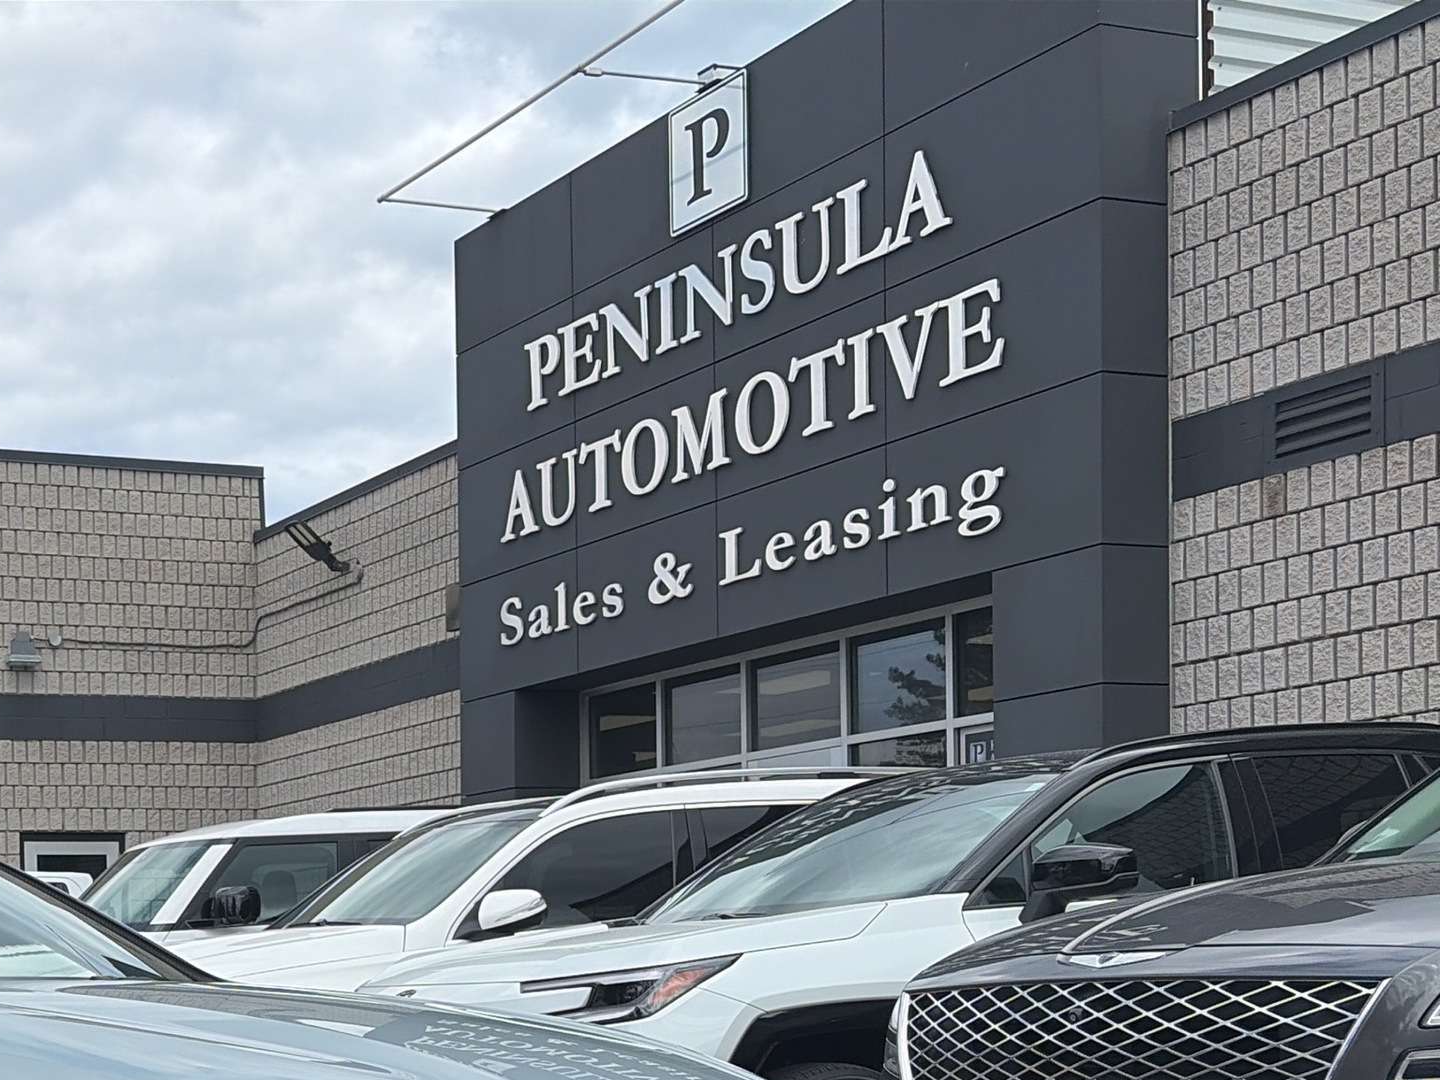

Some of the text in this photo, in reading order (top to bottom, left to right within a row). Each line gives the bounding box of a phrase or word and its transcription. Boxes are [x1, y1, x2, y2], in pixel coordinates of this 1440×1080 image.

[684, 106, 730, 207] P
[524, 150, 954, 412] PENINSULA
[500, 278, 1006, 544] AUTOMOTIVE
[499, 465, 1006, 646] Sales & Leasing
